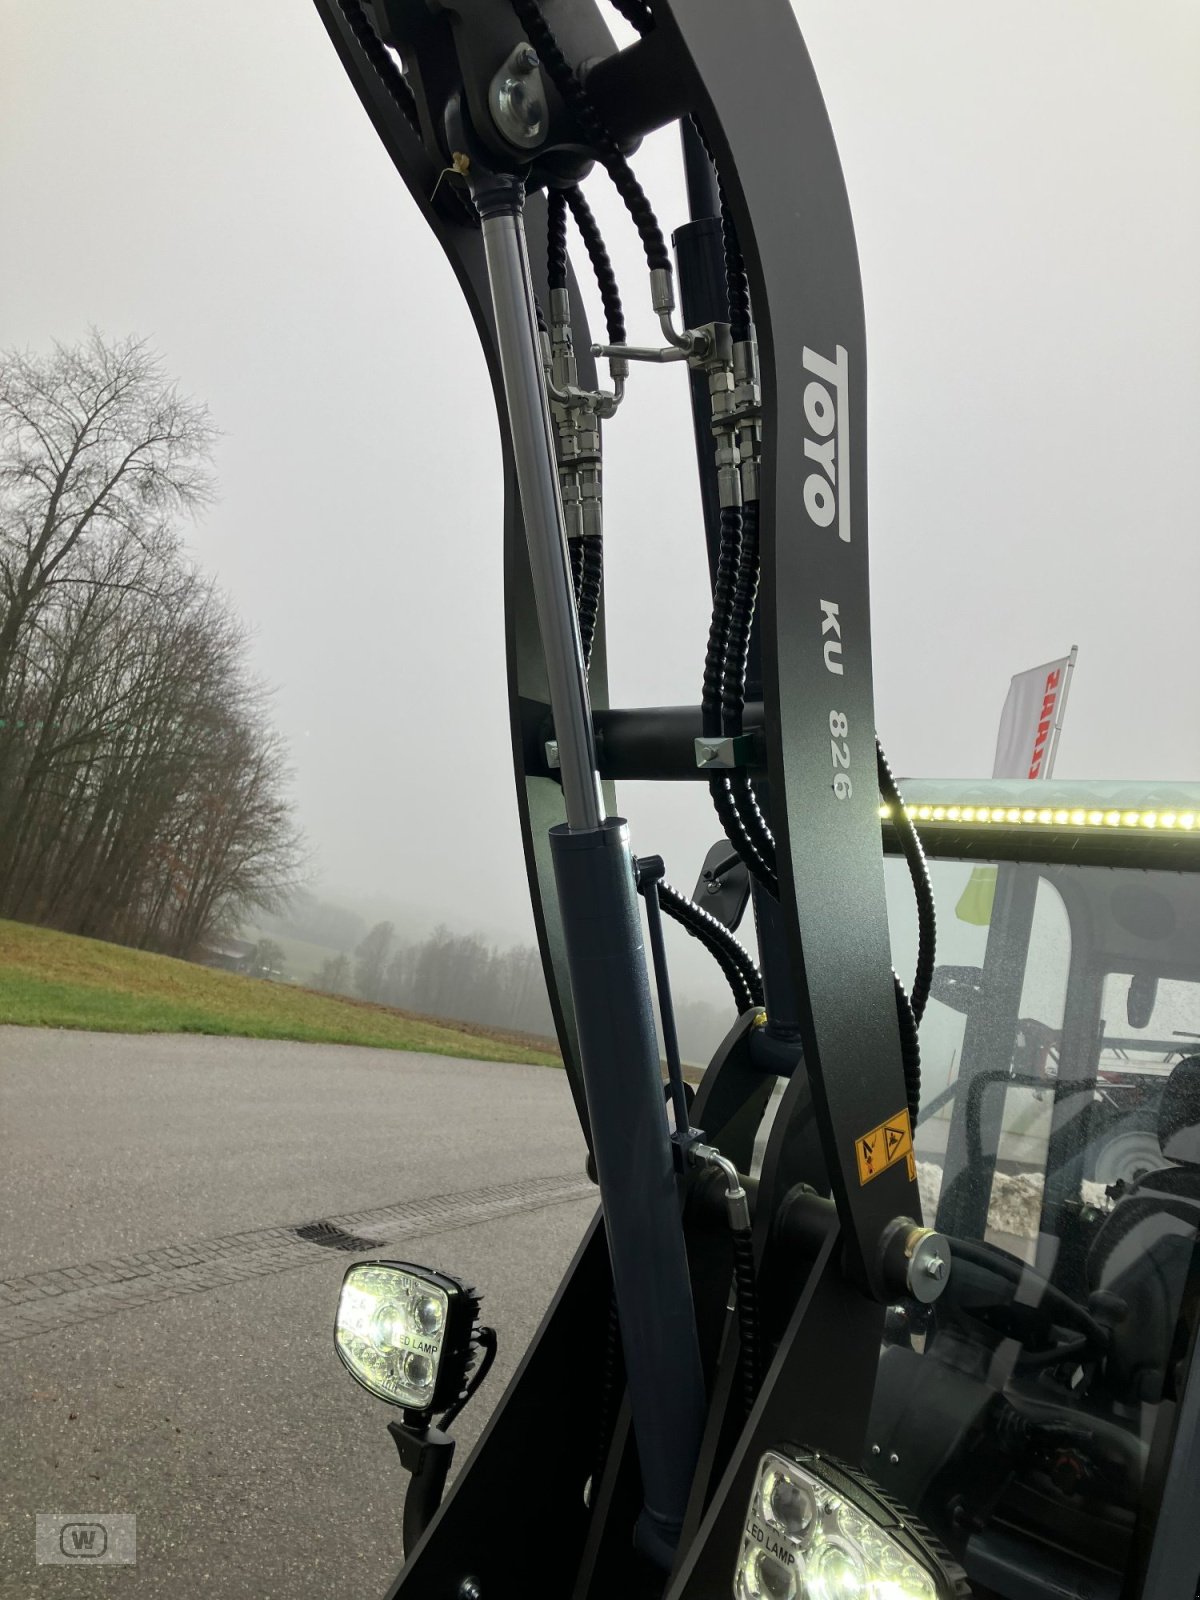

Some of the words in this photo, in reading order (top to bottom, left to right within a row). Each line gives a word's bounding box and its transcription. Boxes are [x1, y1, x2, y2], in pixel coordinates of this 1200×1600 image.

[802, 344, 851, 543] TOYO
[819, 599, 844, 676] KU
[828, 709, 853, 801] 826
[412, 1339, 438, 1355] LAMP
[745, 1519, 764, 1543] LED
[765, 1536, 796, 1566] LAMP
